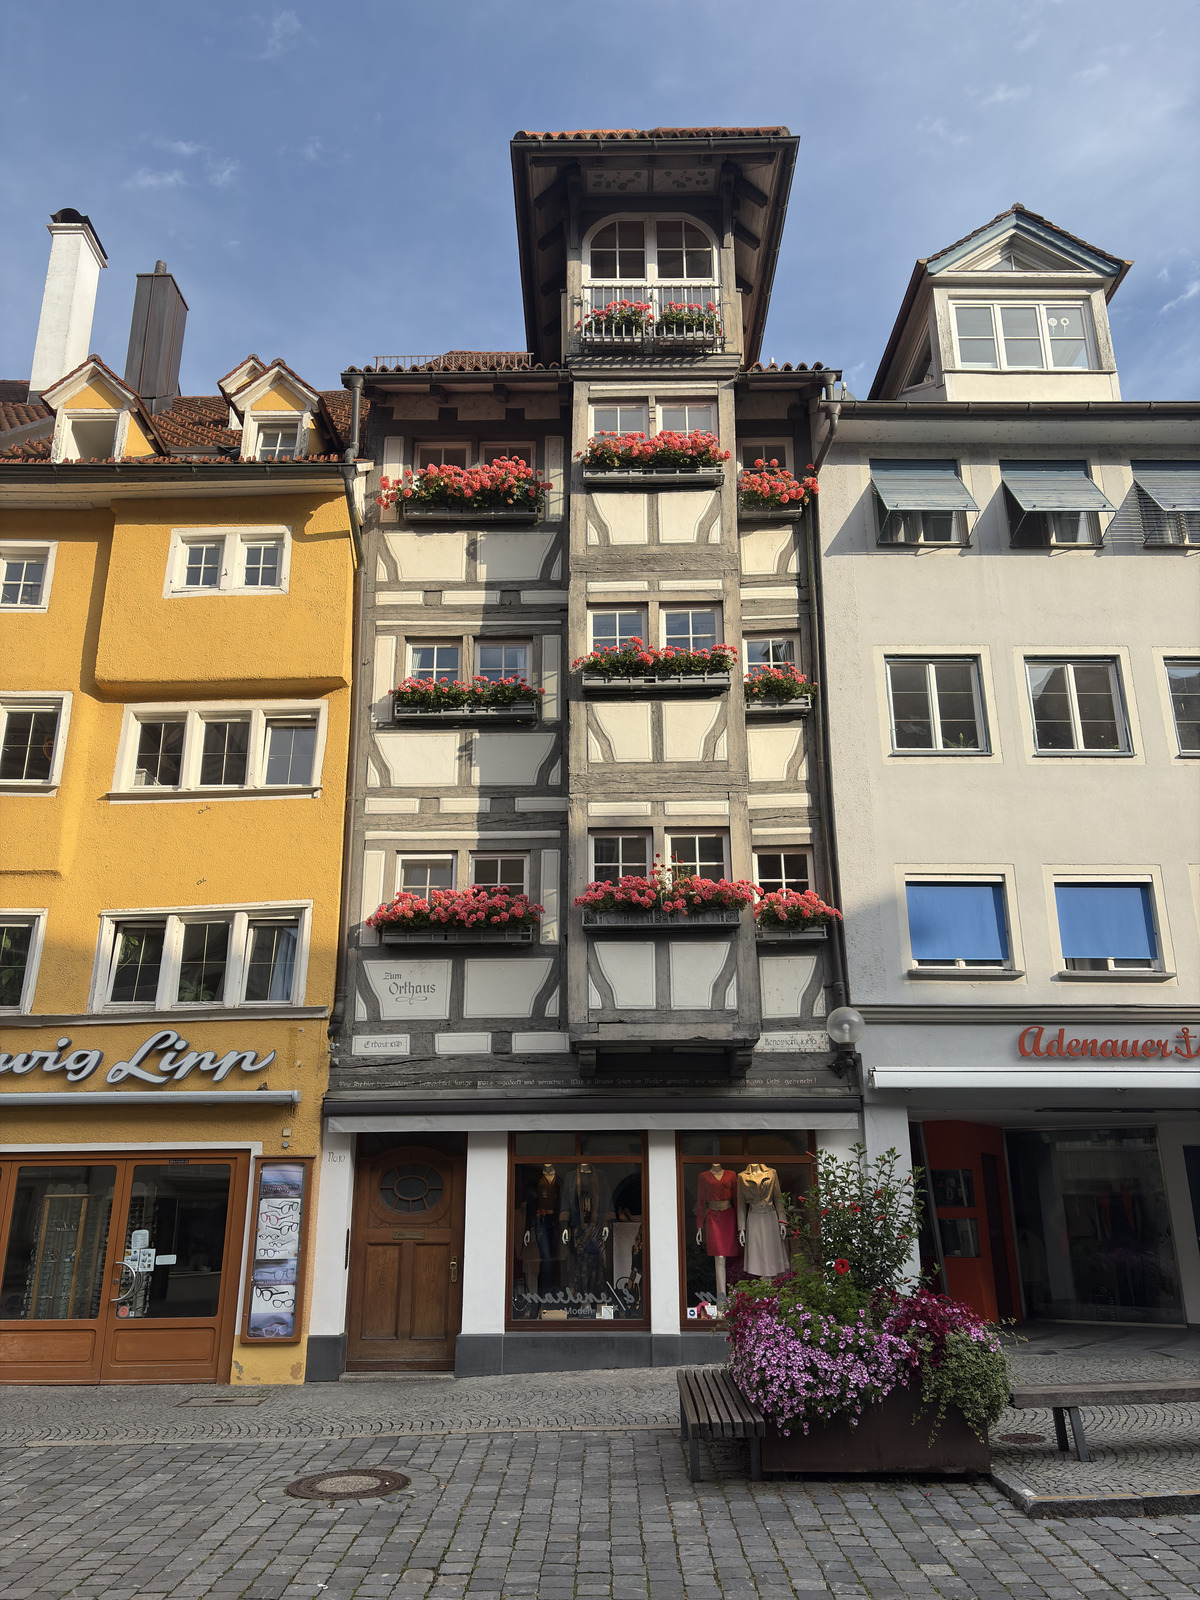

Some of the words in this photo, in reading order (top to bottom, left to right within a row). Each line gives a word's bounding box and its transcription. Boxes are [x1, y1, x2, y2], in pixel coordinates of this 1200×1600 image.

[382, 972, 402, 980] Zum
[389, 981, 436, 997] Orthaus
[1018, 1026, 1173, 1058] Adenauer
[105, 1029, 276, 1085] Lipp
[564, 1306, 593, 1315] Moden
